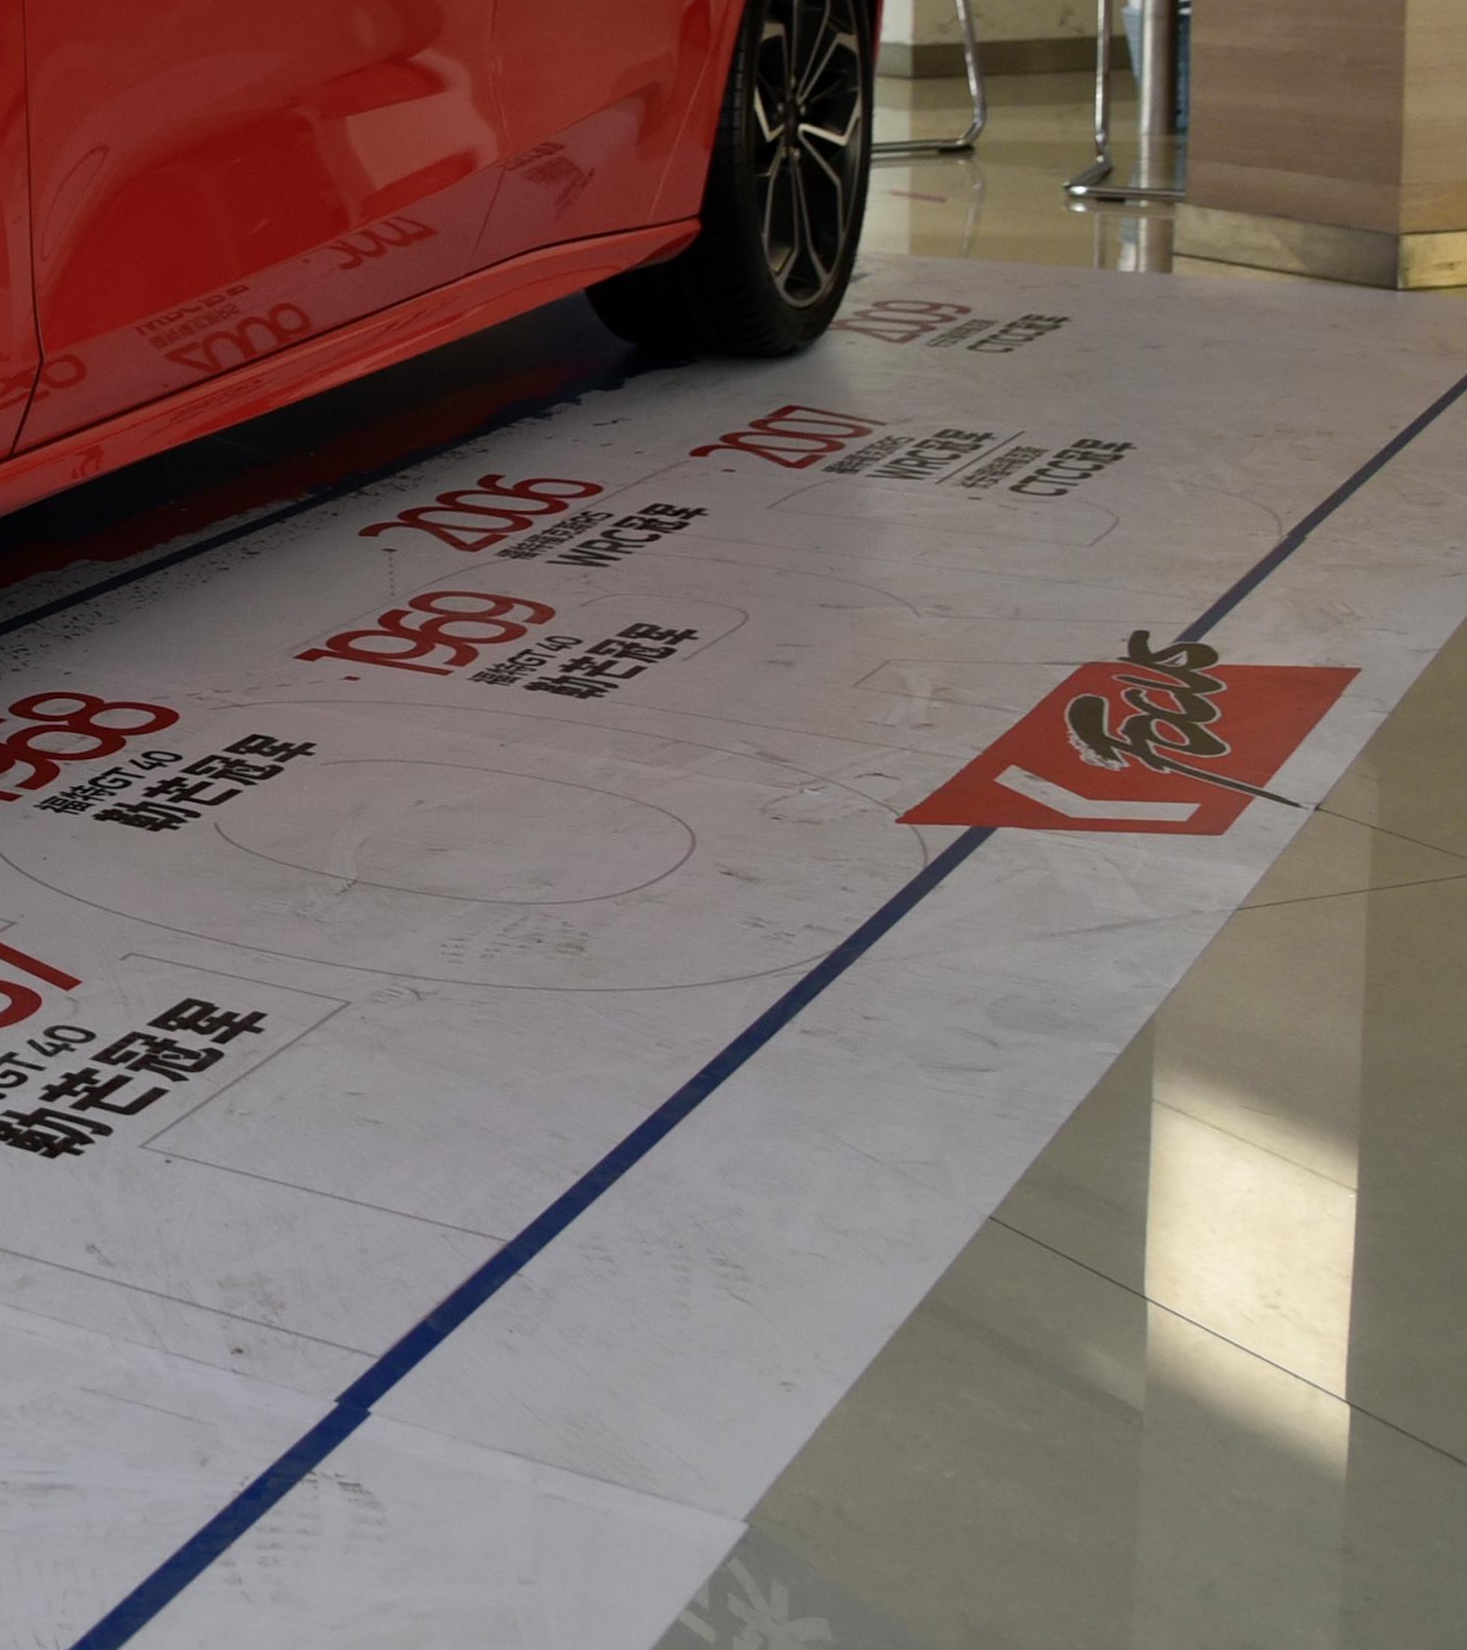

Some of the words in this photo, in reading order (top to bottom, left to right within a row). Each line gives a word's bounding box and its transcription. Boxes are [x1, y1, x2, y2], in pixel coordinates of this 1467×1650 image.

[689, 405, 887, 469] 2007
[867, 428, 999, 480] WRC冠军
[1008, 438, 1138, 497] CTCC冠军
[358, 474, 603, 552] 2006
[546, 503, 709, 569] WRC冠军
[293, 591, 557, 676] 1969
[467, 644, 561, 687] 福特GT
[542, 635, 584, 656] 40
[524, 622, 701, 700] 勒芒冠军
[33, 766, 148, 815] 福特GT
[140, 750, 183, 770] 40
[92, 733, 317, 832] 勒芒冠军
[41, 1024, 97, 1059] 40
